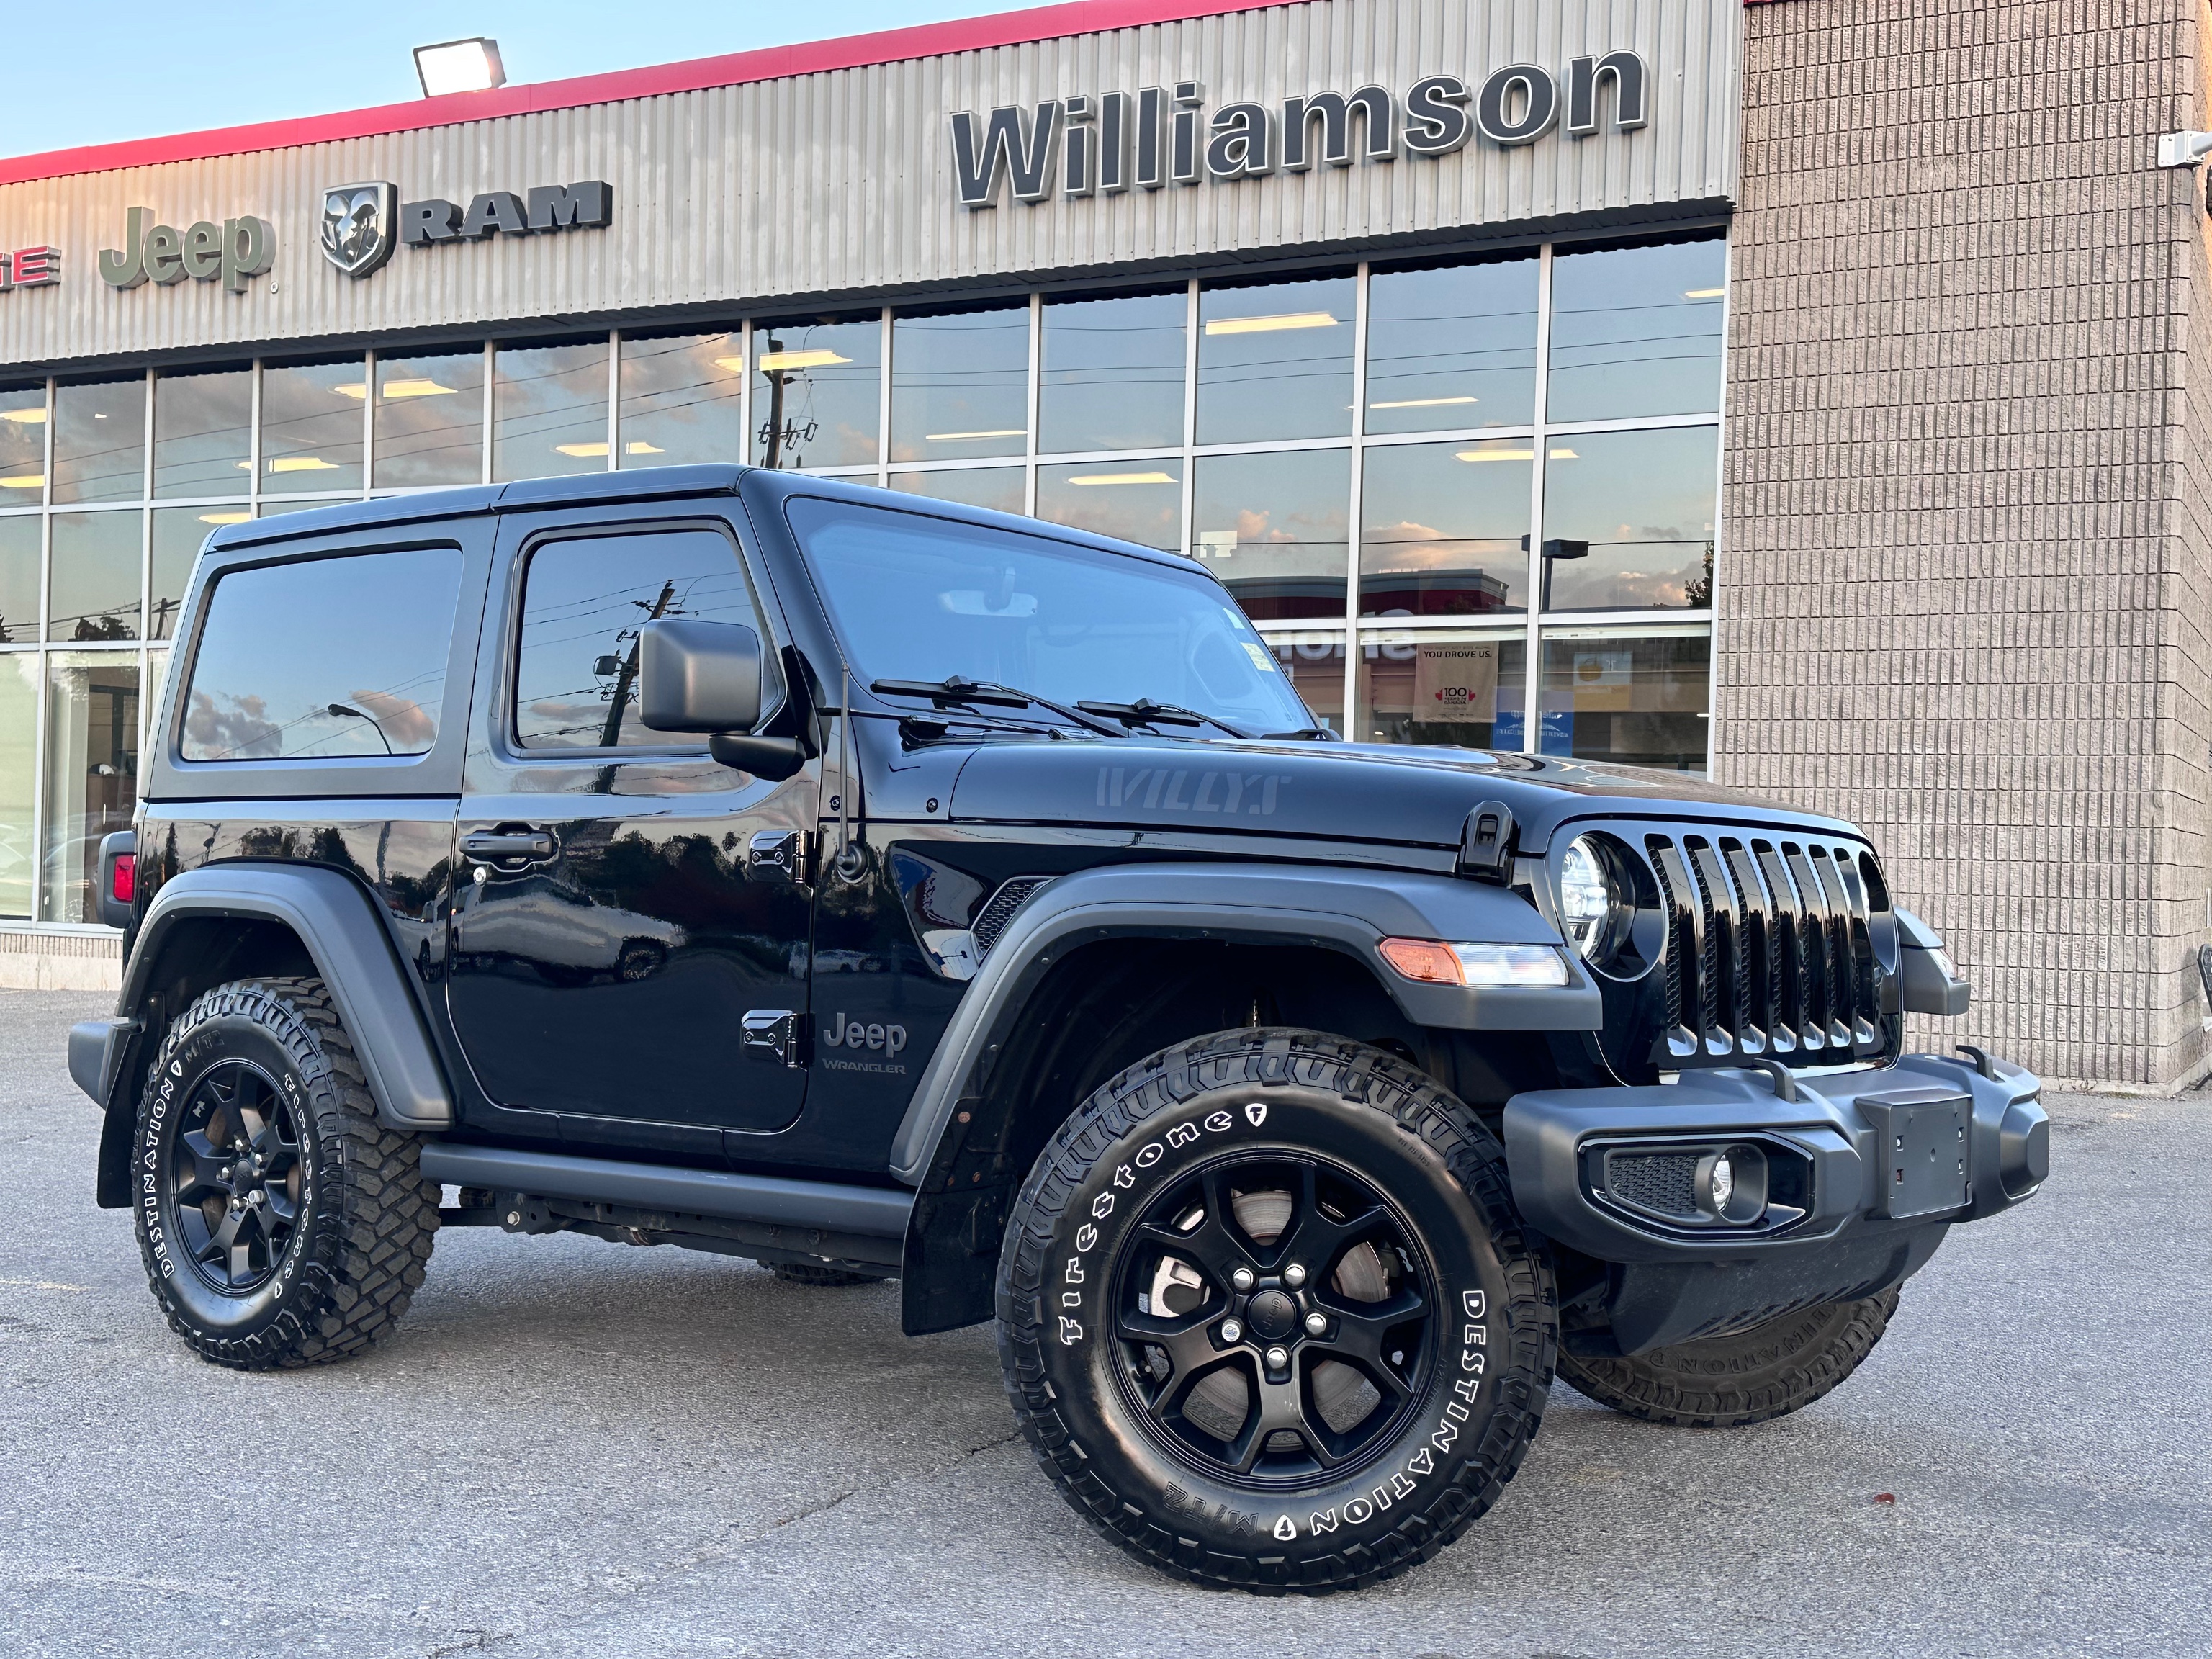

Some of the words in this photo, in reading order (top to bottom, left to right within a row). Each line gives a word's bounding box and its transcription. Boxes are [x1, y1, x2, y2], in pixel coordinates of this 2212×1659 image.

[950, 49, 1649, 208] Williamson
[98, 206, 274, 292] Jeep
[400, 180, 613, 246] RAM
[1444, 687, 1467, 697] 100
[1096, 767, 1292, 815] WILLYS
[822, 1058, 907, 1074] WRANGLER
[823, 1012, 907, 1058] Jeep
[144, 1076, 175, 1279] DESTINATION
[1059, 1109, 1233, 1346] Firestone
[1309, 1289, 1487, 1536] DESTINATION
